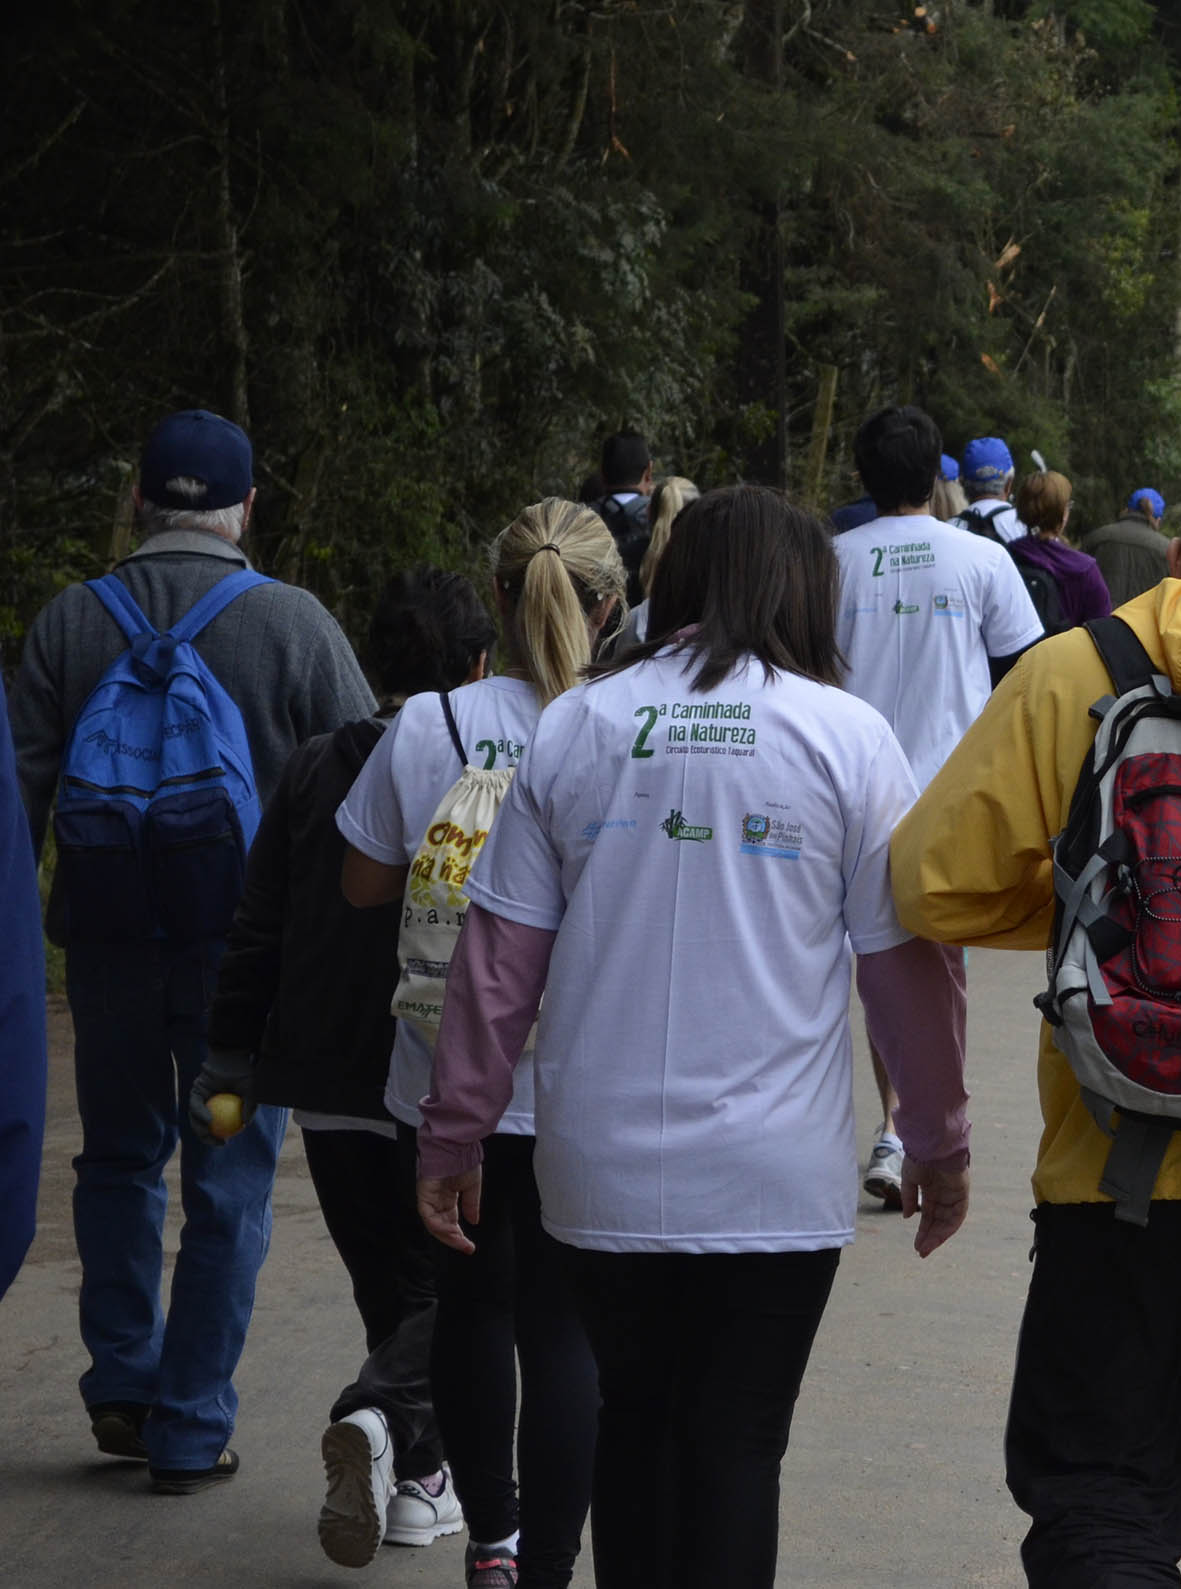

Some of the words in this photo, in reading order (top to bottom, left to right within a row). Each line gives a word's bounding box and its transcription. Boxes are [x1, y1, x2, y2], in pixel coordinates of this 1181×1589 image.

[889, 542, 931, 554] Caminhada
[890, 557, 899, 567] na
[901, 553, 935, 566] Natureza
[671, 701, 751, 720] Caminhada
[668, 725, 686, 742] na
[690, 723, 756, 745] Natureza
[678, 827, 711, 838] ACAMP
